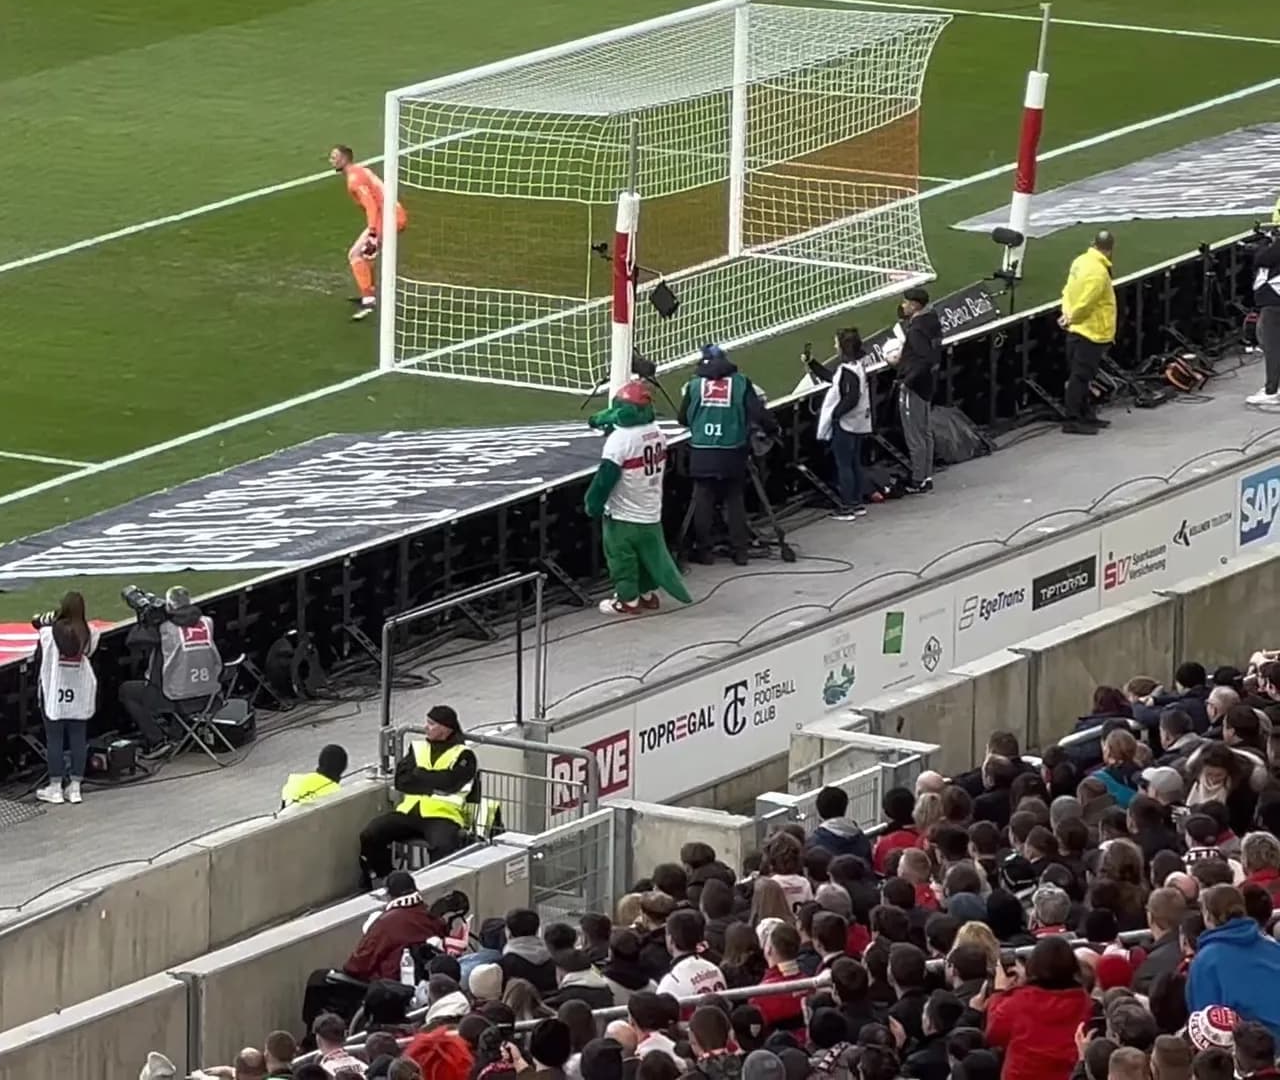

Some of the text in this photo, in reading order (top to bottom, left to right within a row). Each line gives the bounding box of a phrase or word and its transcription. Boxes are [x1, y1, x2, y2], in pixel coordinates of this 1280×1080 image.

[704, 423, 723, 436] 01
[643, 442, 662, 477] 92
[1241, 478, 1280, 532] SAP
[979, 588, 1025, 620] EgeTrans
[189, 667, 209, 682] 28
[754, 669, 771, 687] THE
[753, 680, 796, 705] FOOTBALL
[753, 706, 776, 728] CLUB
